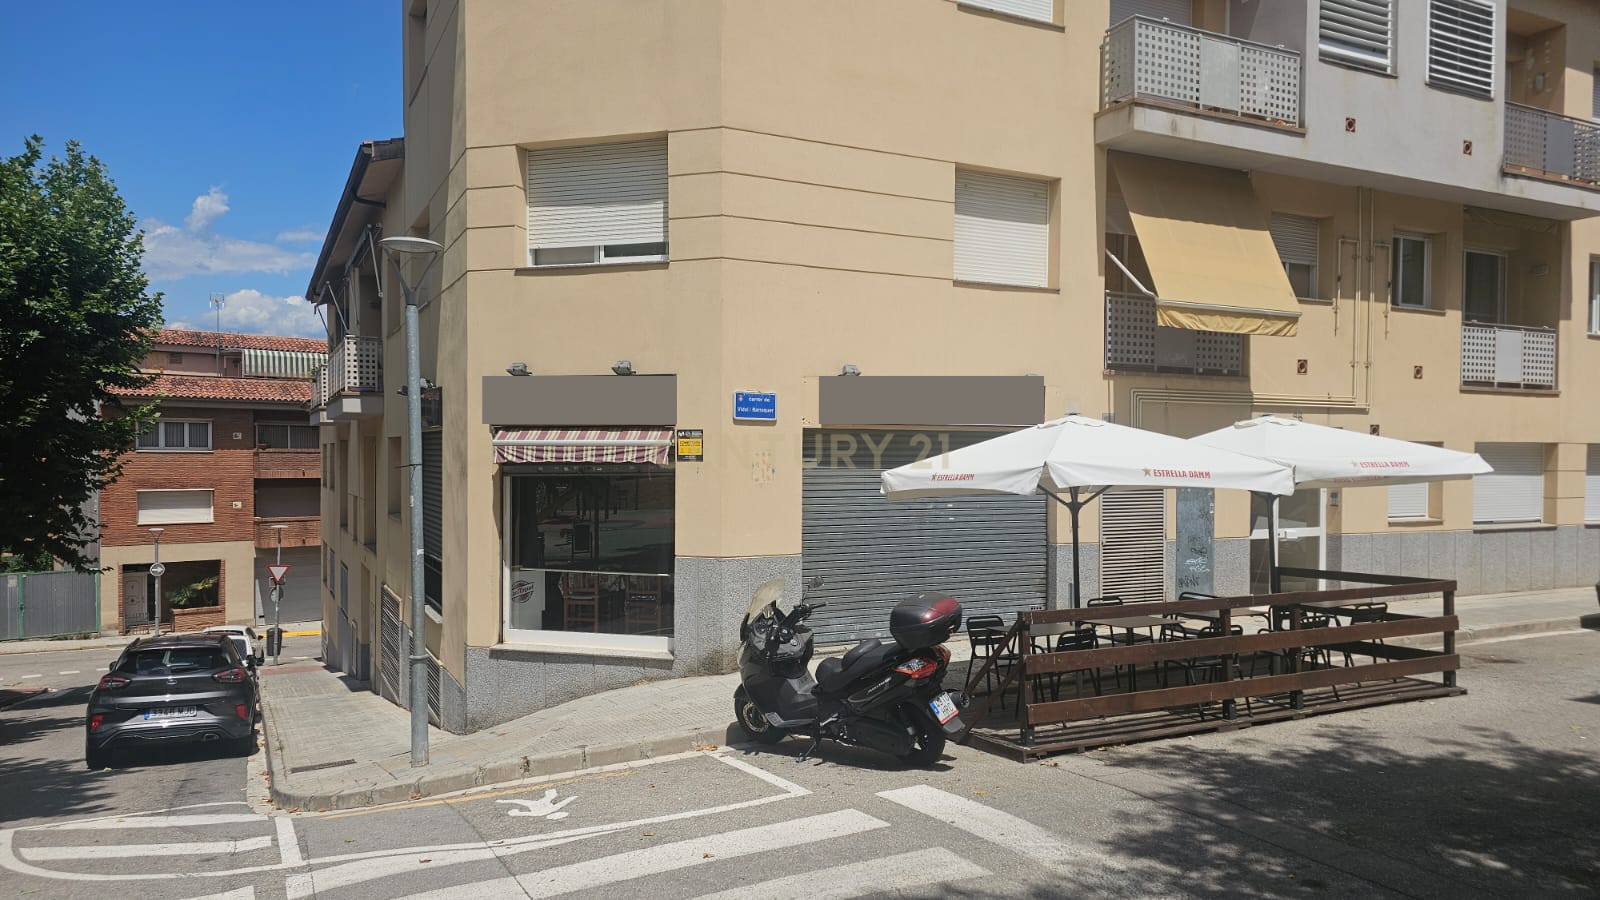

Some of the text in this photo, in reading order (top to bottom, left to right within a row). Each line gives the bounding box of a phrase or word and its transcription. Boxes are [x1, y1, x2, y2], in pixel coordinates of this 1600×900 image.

[936, 473, 975, 481] ESTRELLA DAMM
[1153, 468, 1211, 479] ESTRELLA DAMM
